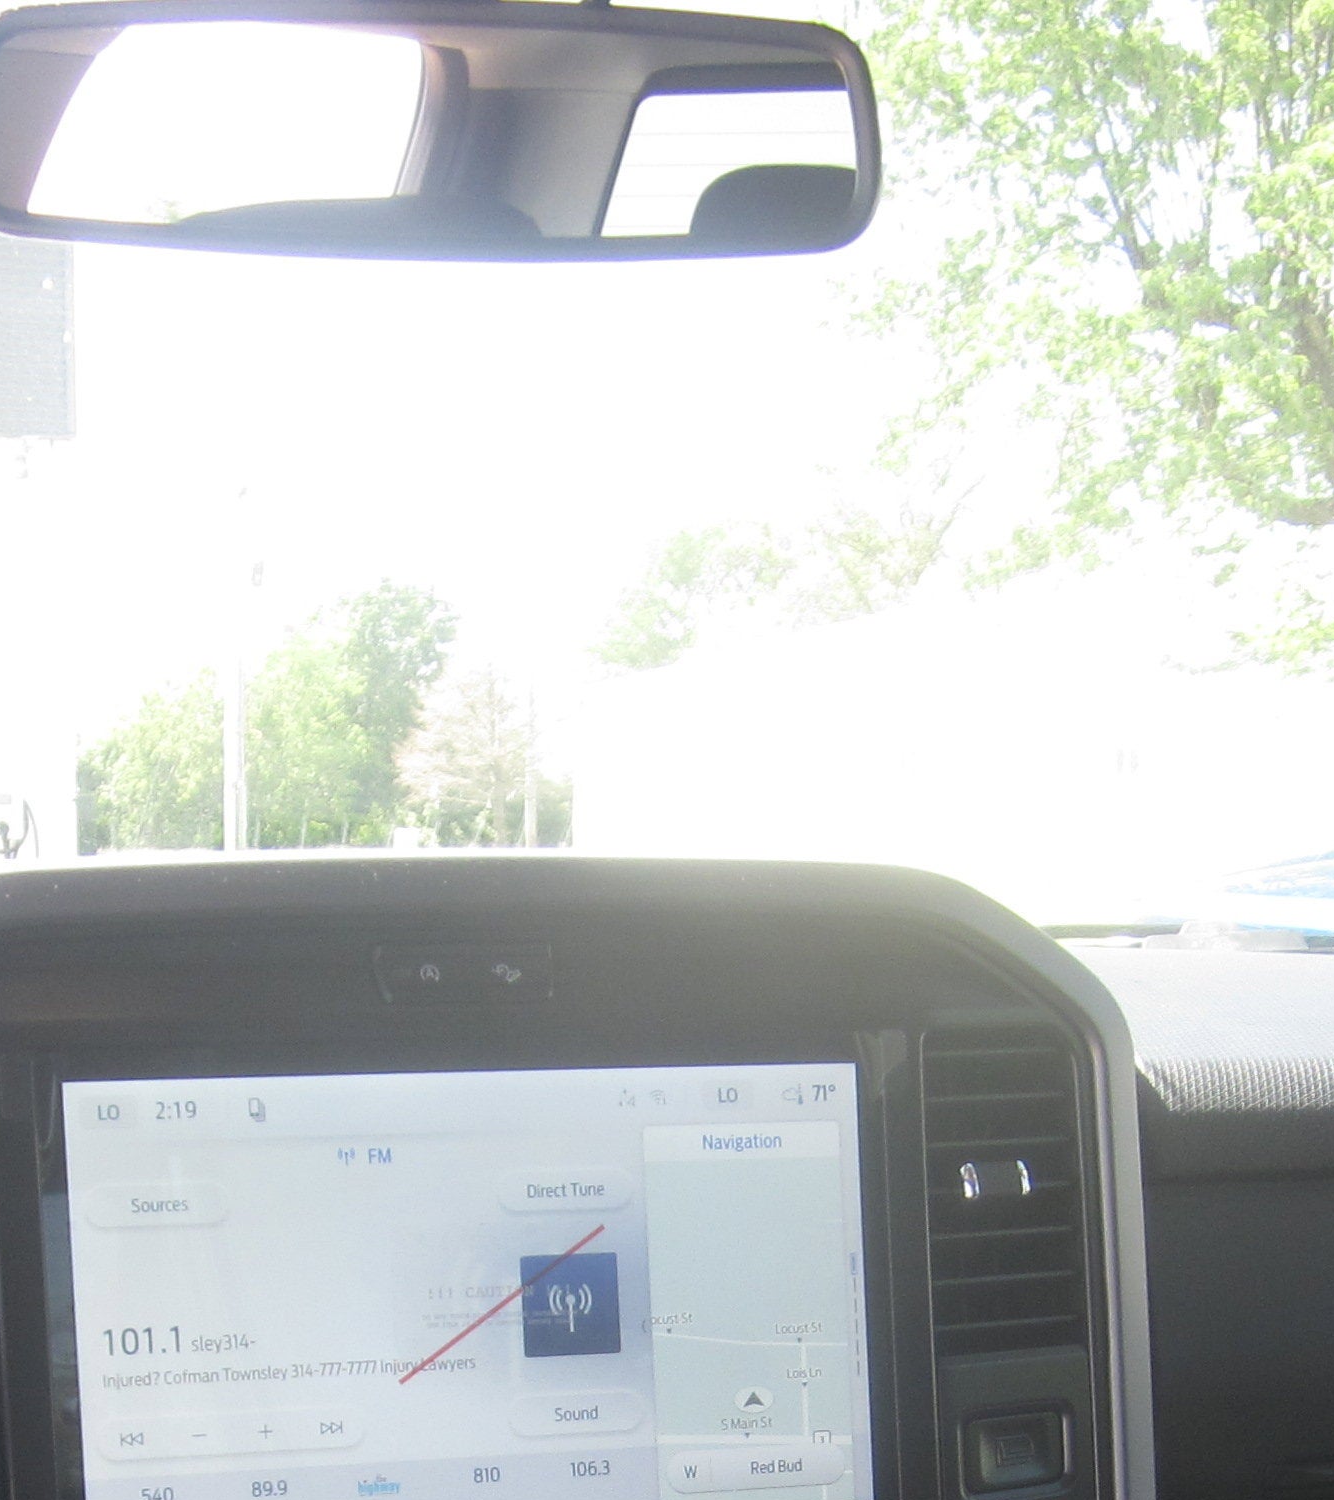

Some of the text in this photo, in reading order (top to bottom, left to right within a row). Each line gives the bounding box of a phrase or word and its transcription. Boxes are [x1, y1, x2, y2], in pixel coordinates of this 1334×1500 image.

[717, 1087, 739, 1103] LO
[97, 1104, 120, 1121] LO
[155, 1100, 197, 1120] 2:19
[702, 1133, 782, 1152] Navigation
[368, 1148, 392, 1164] FM
[526, 1181, 605, 1198] Direct Tune
[131, 1198, 189, 1214] Sources
[651, 1314, 679, 1325] ocust
[775, 1321, 822, 1334] Locust St
[103, 1326, 256, 1356] 101.1 sley314-
[103, 1371, 160, 1390] Injured?
[164, 1367, 219, 1385] Cofman
[223, 1363, 287, 1383] Townsley
[291, 1360, 377, 1379] 314-777-7777
[380, 1359, 417, 1376] Injury
[555, 1406, 599, 1422] Sound
[731, 1417, 758, 1430] Main
[760, 1416, 772, 1428] St
[473, 1467, 501, 1484] 810
[570, 1460, 611, 1478] 106.3
[684, 1457, 803, 1479] W Red Bud
[251, 1480, 288, 1498] 89.9
